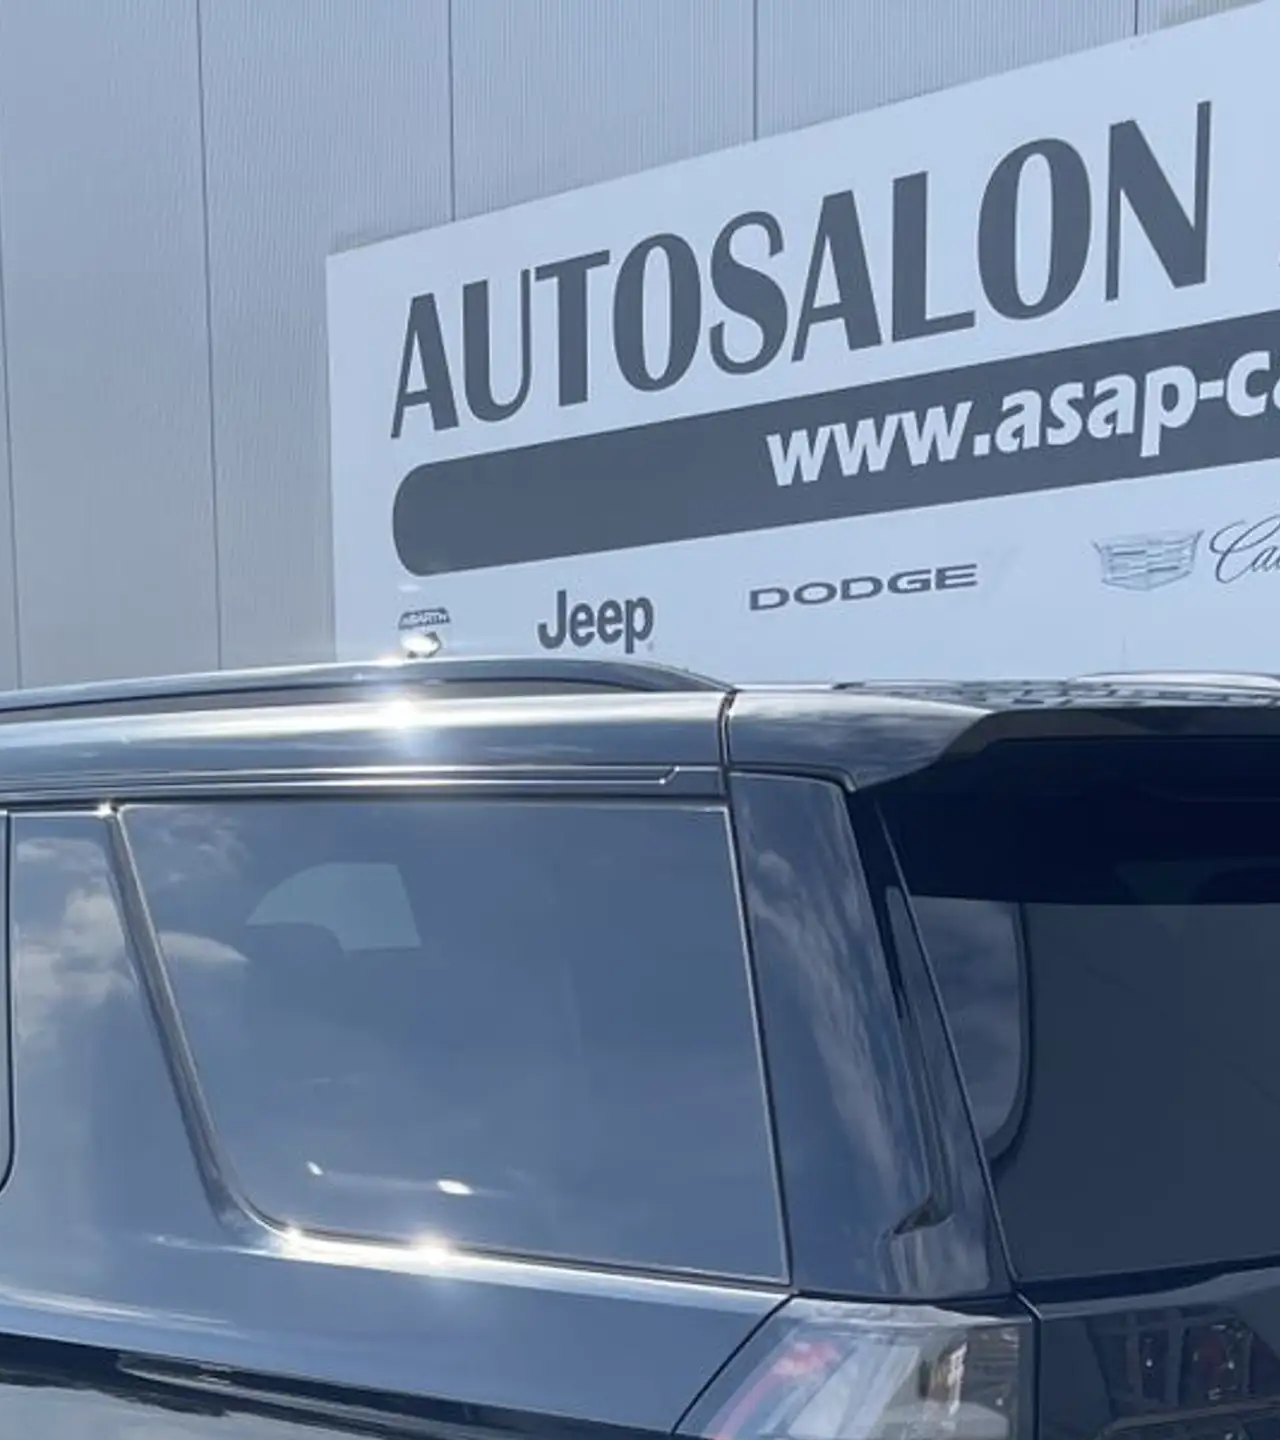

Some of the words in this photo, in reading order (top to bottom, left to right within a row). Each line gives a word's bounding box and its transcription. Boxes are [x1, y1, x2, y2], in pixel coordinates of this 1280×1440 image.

[391, 101, 1212, 438] AUTOSALON
[749, 563, 978, 611] DODGE
[537, 589, 654, 654] Jeep
